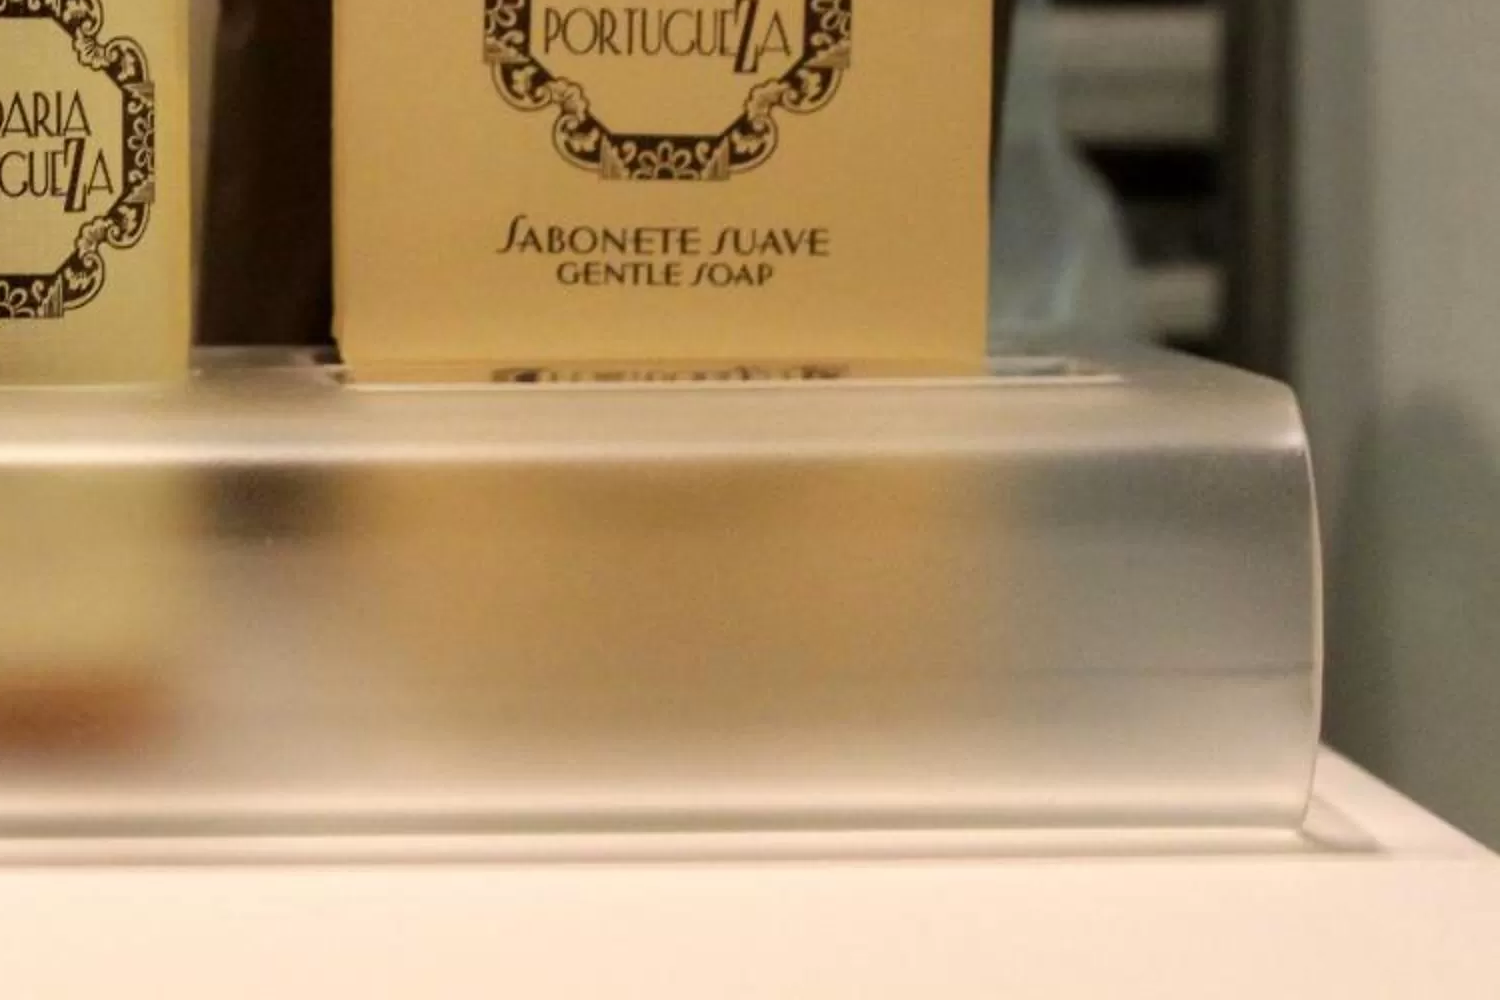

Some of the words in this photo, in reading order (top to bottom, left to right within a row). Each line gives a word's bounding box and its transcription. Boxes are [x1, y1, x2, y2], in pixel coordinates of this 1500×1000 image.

[496, 214, 702, 255] SABONETE
[710, 226, 830, 257] SUAVE
[555, 262, 682, 286] GENTLE
[690, 262, 775, 287] SOAP
